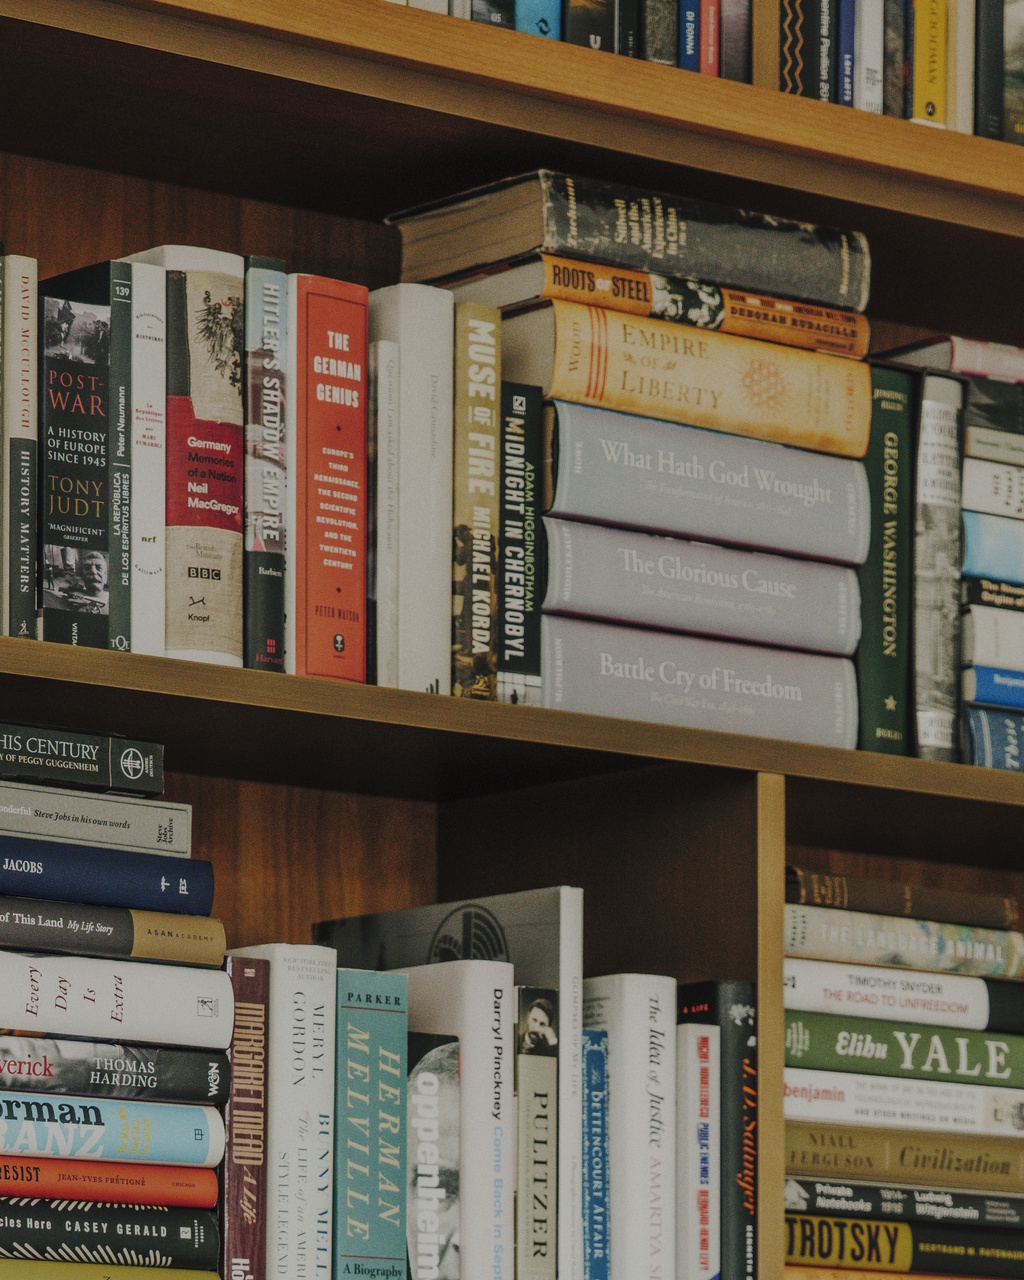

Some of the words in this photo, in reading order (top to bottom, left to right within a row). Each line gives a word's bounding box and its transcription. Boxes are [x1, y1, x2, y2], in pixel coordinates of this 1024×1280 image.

[686, 25, 695, 55] DONNA
[21, 275, 29, 322] DAVID
[552, 265, 596, 293] ROOTS
[612, 278, 651, 303] STEEL
[262, 282, 281, 372] HITLER'S
[327, 331, 349, 352] THE
[622, 323, 710, 360] EMPIRE
[314, 356, 361, 382] GERMAN
[467, 320, 496, 399] MUSE
[49, 370, 104, 390] POST-
[317, 383, 359, 408] GENIUS
[620, 373, 723, 410] LIBERTY
[49, 388, 105, 417] WAR
[117, 386, 125, 427] Neumann
[262, 377, 282, 461] SHADOW
[474, 407, 489, 421] OF
[48, 427, 54, 437] A
[57, 427, 106, 442] HISTORY
[48, 438, 60, 450] OF
[62, 440, 106, 455] EUROPE
[117, 431, 125, 457] Peter
[187, 436, 231, 453] Germany
[48, 450, 79, 465] SINCE
[82, 454, 106, 468] 1945
[467, 431, 495, 497] FIRE
[505, 418, 524, 512] MIDNIGHT
[600, 440, 652, 471] What
[657, 451, 704, 480] Hath
[708, 460, 750, 488] God
[754, 469, 831, 504] Wrought
[884, 431, 899, 514] GEORGE
[20, 451, 29, 516] HISTORY
[49, 475, 104, 498] TONY
[188, 481, 208, 494] Neil
[524, 462, 534, 501] ADAM
[49, 495, 104, 518] JUDT
[187, 497, 240, 515] MacGregor
[262, 463, 281, 540] EMPIRE
[472, 506, 491, 582] MICHAEL
[506, 518, 524, 540] IN
[20, 523, 29, 594] MATTERS
[524, 506, 534, 612] HIGGINBOTHAM
[504, 546, 524, 661] CHERNOBYL
[881, 519, 899, 656] WASHINGTON
[188, 613, 210, 623] Knopf
[472, 587, 490, 654] KORDA
[599, 653, 654, 681] Battle
[659, 661, 695, 692] Cry
[701, 667, 720, 688] of
[723, 672, 802, 700] Freedom
[18, 755, 44, 767] PEGGY
[46, 758, 99, 773] GUGGENHEIM
[26, 736, 99, 763] CENTURY
[34, 809, 54, 821] Steve
[54, 812, 71, 824] Jobs
[72, 815, 79, 824] in
[81, 815, 92, 826] his
[93, 820, 108, 829] own
[109, 820, 130, 831] words
[3, 858, 43, 874] JACOBS
[13, 912, 36, 926] This
[38, 915, 63, 928] Land
[148, 929, 173, 938] ASAN
[175, 933, 214, 941] ACADEMY
[26, 966, 43, 1016] Every
[55, 976, 71, 1011] Day
[83, 988, 96, 1003] Is
[110, 975, 122, 1023] Extra
[347, 991, 402, 1007] PARKER
[493, 987, 504, 1040] Darryl
[94, 1057, 155, 1073] THOMAS
[892, 1031, 1011, 1079] YALE
[90, 1072, 158, 1088] HARDING
[493, 1045, 504, 1121] Pinckney
[347, 1021, 370, 1240] MELVILLE
[378, 1045, 402, 1228] HERMAN
[58, 1173, 103, 1183] JEAN-YVES
[105, 1174, 146, 1186] FRÉTIGNÉ
[532, 1092, 549, 1258] PULITZER
[65, 1221, 108, 1233] CASEY
[117, 1223, 167, 1238] GERALD
[785, 1217, 899, 1263] TROTSKY
[343, 1262, 351, 1275] A
[352, 1263, 404, 1280] Biography
